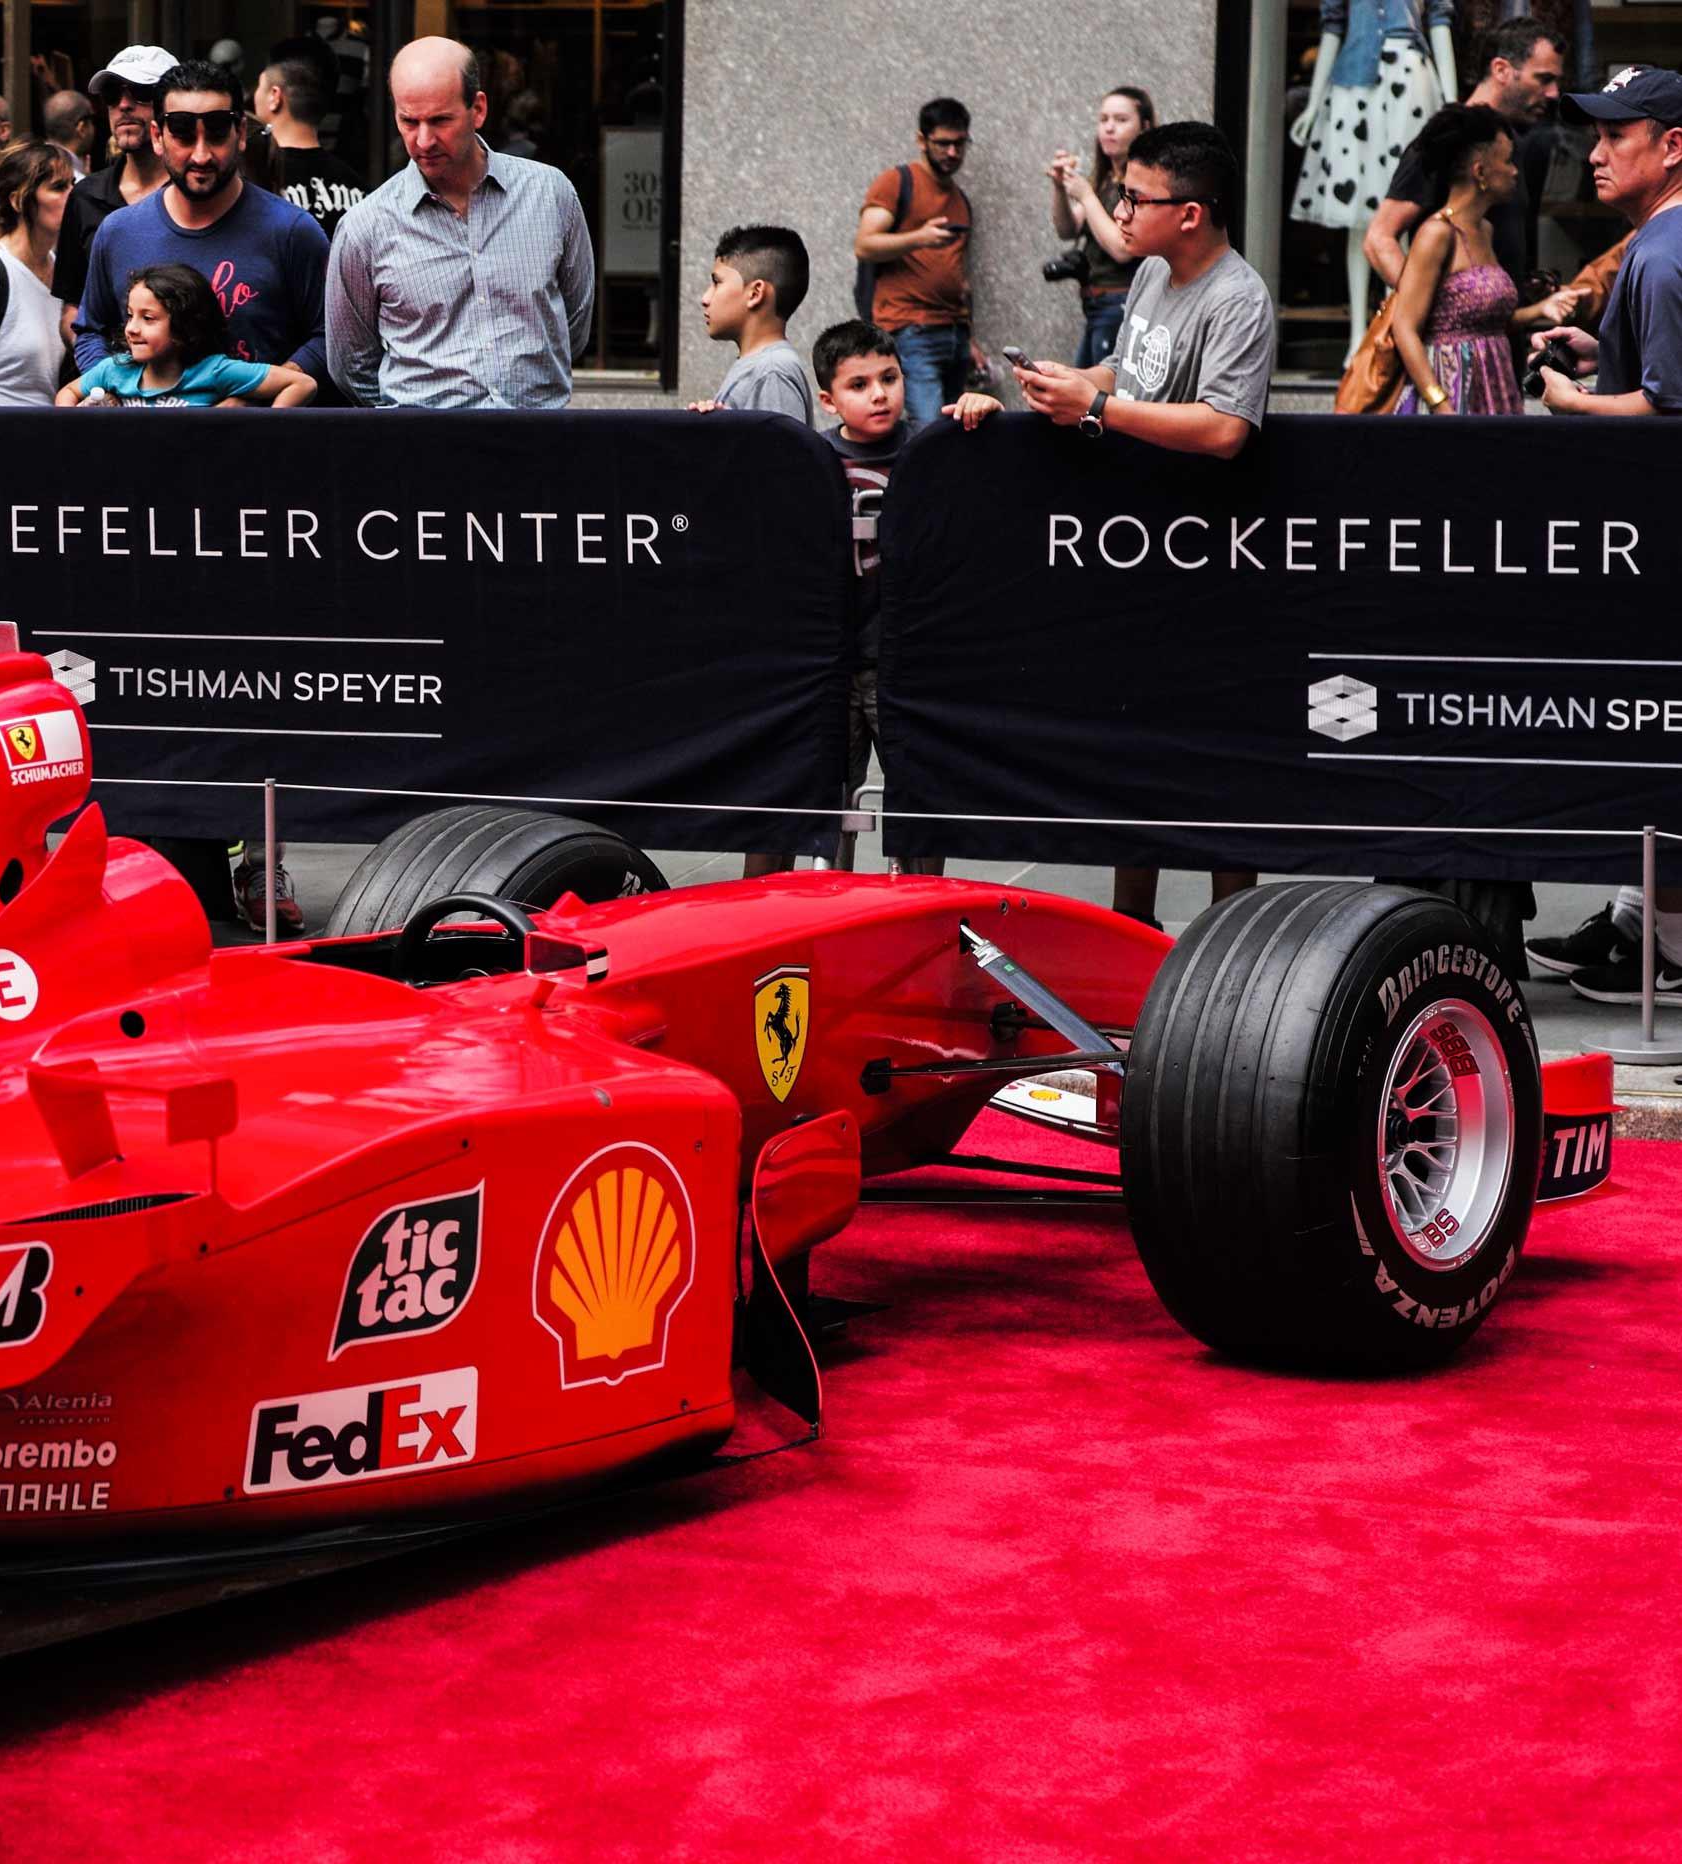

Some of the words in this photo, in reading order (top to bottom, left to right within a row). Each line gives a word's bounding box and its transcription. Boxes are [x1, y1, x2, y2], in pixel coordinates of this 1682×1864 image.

[623, 170, 661, 194] 30
[1047, 513, 1641, 575] ROCKEFELLER
[109, 666, 281, 701] TISHMAN
[292, 671, 442, 705] SPEYER
[1396, 692, 1596, 729] TISHMAN
[1605, 697, 1682, 733] SPE
[10, 760, 85, 786] SCHUMACHER
[1377, 944, 1524, 1028] BRIDGESTONE
[1428, 1021, 1481, 1078] BBS
[1552, 1119, 1609, 1179] TIM
[381, 1210, 461, 1278] tic
[1408, 1207, 1460, 1254] BBS
[356, 1262, 458, 1328] tac
[1374, 1243, 1515, 1329] POTENZA
[24, 1392, 113, 1410] Alenia
[249, 1384, 468, 1486] FedEx
